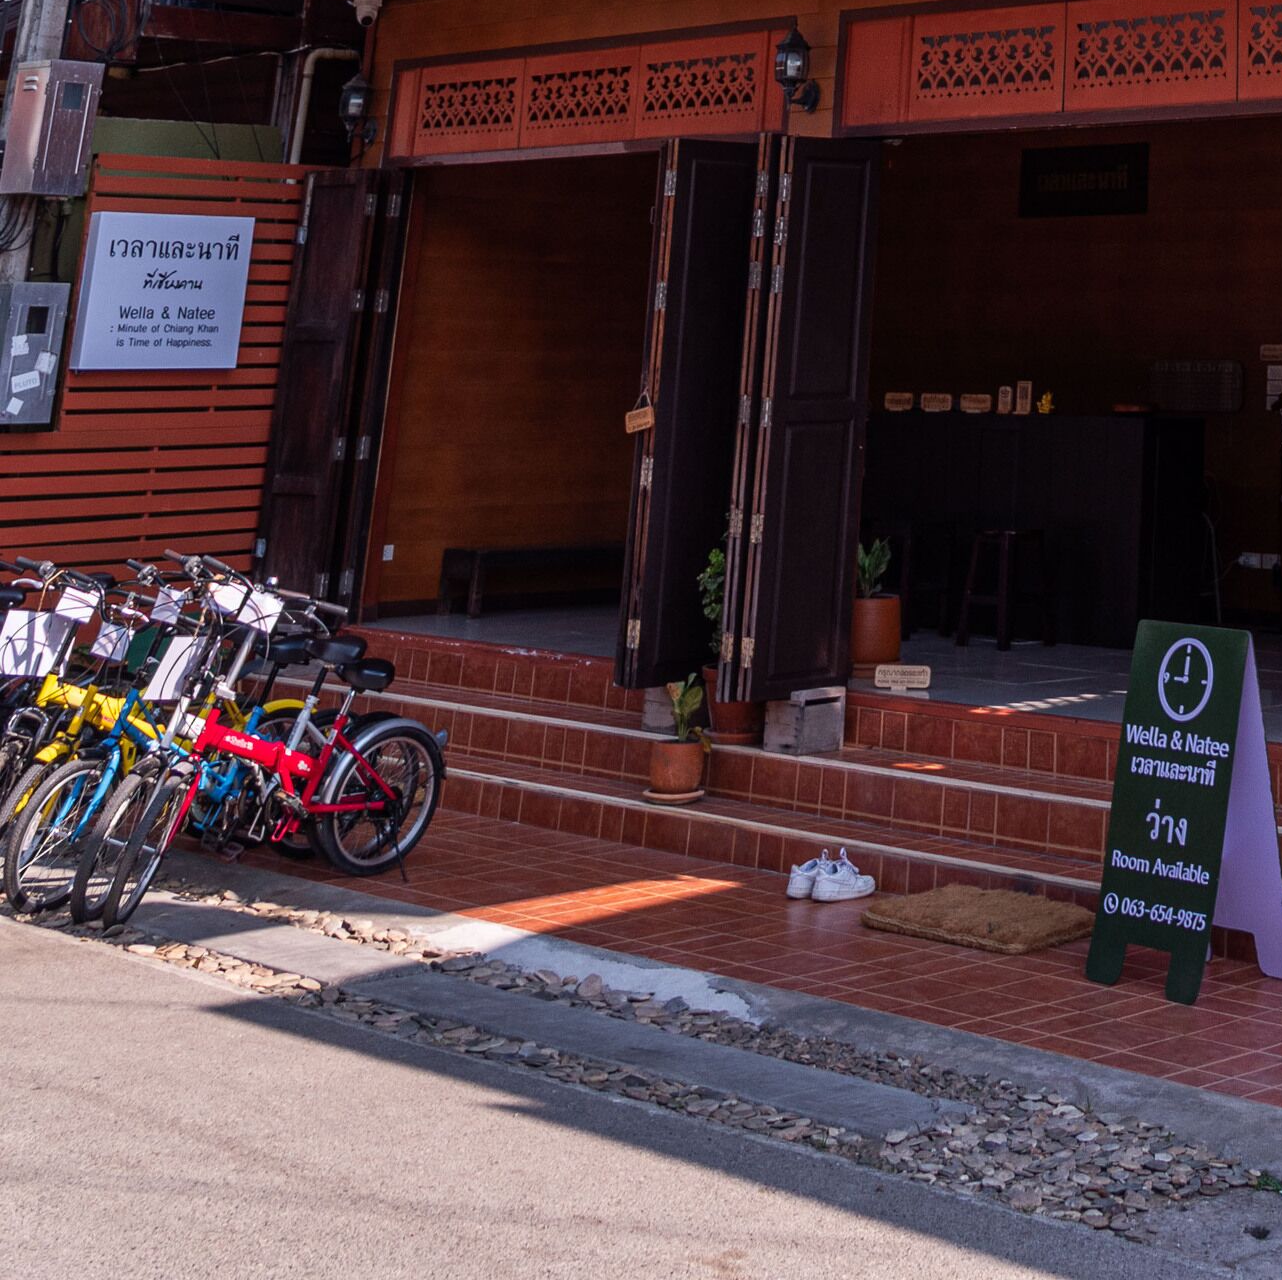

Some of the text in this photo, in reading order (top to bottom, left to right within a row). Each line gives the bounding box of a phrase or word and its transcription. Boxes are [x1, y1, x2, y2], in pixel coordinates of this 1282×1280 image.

[109, 233, 240, 261] เวลาและนาที
[119, 305, 216, 320] Wella & Natee
[116, 338, 213, 349] is Time of Happiness.
[117, 324, 147, 333] Minute
[151, 324, 160, 333] of
[163, 324, 194, 335] Chiang
[197, 324, 219, 333] Khan
[1163, 671, 1170, 684] 9
[1126, 723, 1230, 758] Wella & Natee
[1130, 756, 1217, 786] เวลาและนาที
[1145, 798, 1188, 846] ว่าง
[1111, 849, 1210, 885] Room Available
[1121, 897, 1207, 932] 063-654-9875
